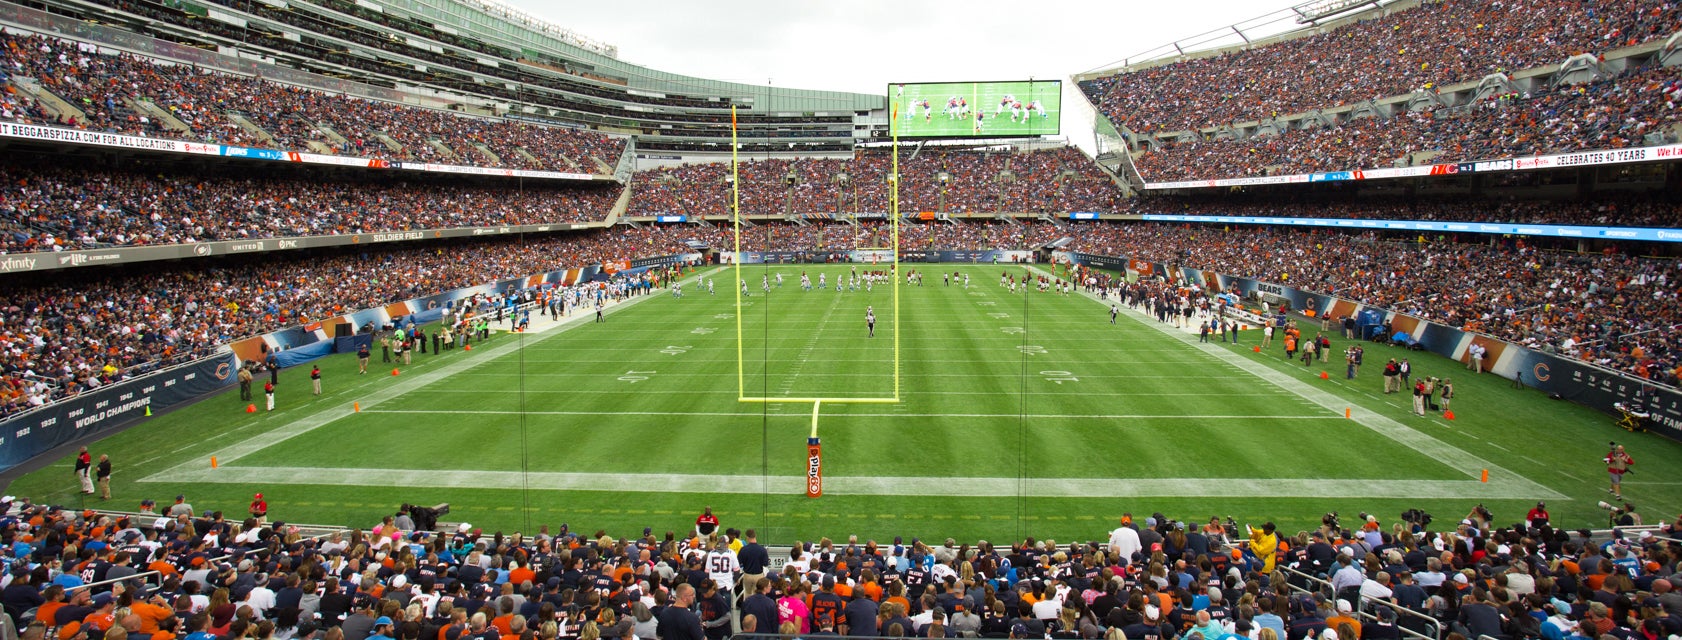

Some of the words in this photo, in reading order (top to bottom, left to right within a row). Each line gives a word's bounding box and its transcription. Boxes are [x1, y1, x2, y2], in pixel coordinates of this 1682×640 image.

[12, 125, 100, 144] BEGGARSPIZZA.COM
[103, 135, 117, 145] FOR
[120, 137, 134, 147] ALL
[136, 138, 176, 150] LOCATIONS
[1556, 153, 1603, 166] CELEBRATES
[1605, 152, 1615, 162] 40
[1617, 149, 1646, 161] YEARS
[1657, 148, 1671, 157] We
[1475, 160, 1513, 172] BEARS
[373, 233, 404, 242] SOLDIER
[405, 231, 424, 240] FIELD
[232, 243, 257, 251] UNITED
[285, 241, 297, 249] PNC
[1, 257, 36, 272] xfinity
[71, 253, 87, 266] Lite
[1257, 283, 1282, 295] BEARS
[16, 427, 30, 438] 1932
[41, 417, 56, 428] 1933
[68, 407, 84, 419] 1940
[96, 400, 109, 409] 1941
[120, 392, 133, 401] 1943
[75, 411, 105, 429] WORLD
[106, 396, 151, 418] CHAMPIONS
[1651, 413, 1663, 423] OF
[711, 556, 730, 573] 50
[774, 558, 784, 566] 151
